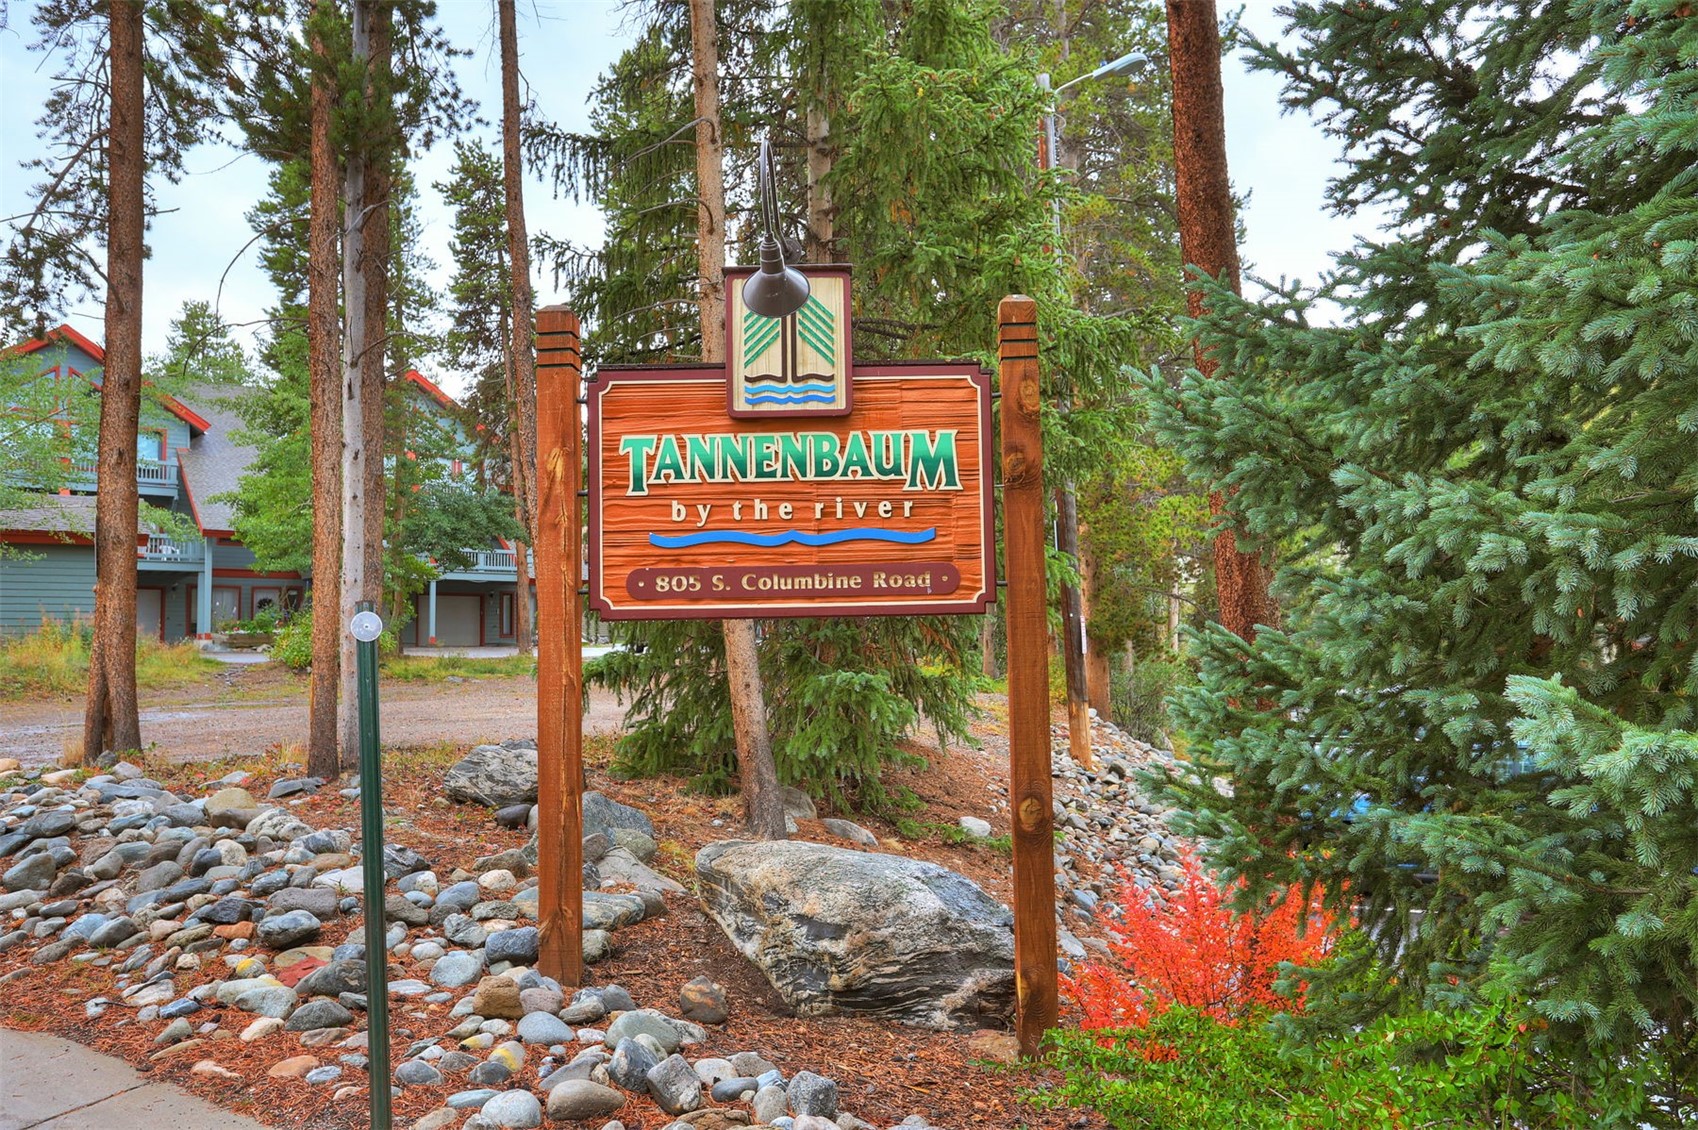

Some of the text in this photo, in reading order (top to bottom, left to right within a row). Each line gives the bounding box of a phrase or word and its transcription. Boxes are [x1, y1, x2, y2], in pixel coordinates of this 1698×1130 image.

[619, 429, 963, 496] TANNENBAUM
[671, 496, 913, 527] by the river
[655, 571, 931, 592] 805 S. Columbine Road
